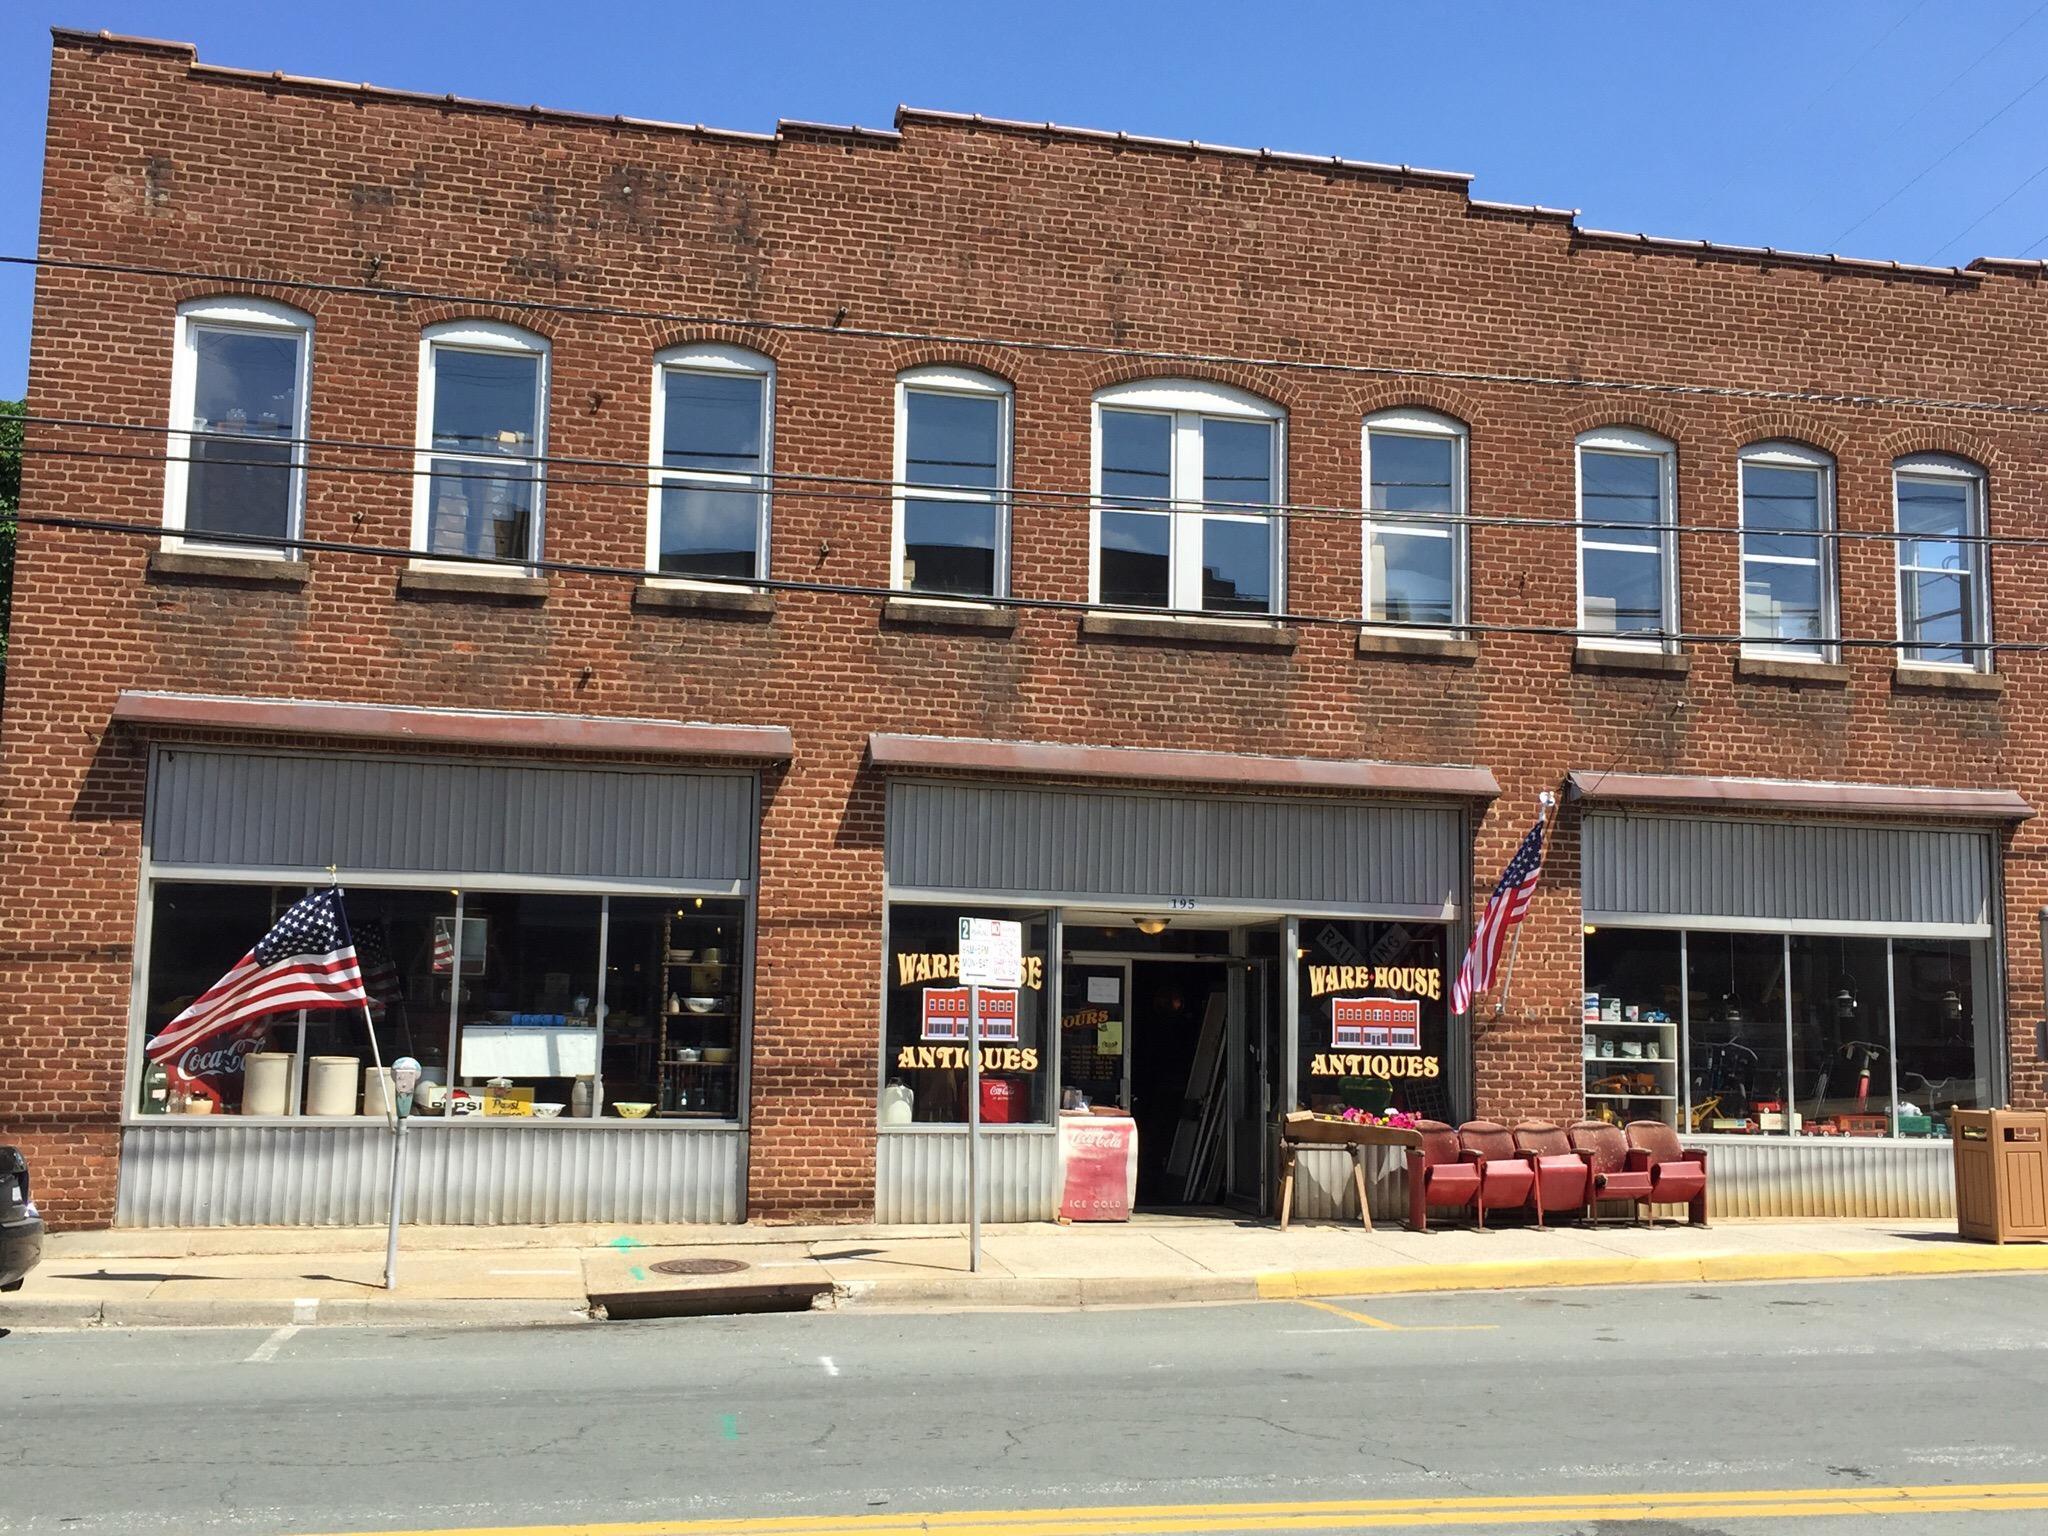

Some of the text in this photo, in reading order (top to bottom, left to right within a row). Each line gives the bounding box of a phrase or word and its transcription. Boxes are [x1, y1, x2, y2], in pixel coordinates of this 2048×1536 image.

[1171, 898, 1195, 909] 195
[962, 920, 969, 939] 2
[898, 953, 960, 986] WARE
[1308, 965, 1442, 1001] WARE HOUSE
[1061, 1010, 1109, 1028] OURS
[1310, 1054, 1440, 1080] ANTIQUES
[1069, 1200, 1121, 1208] ICE COLD
